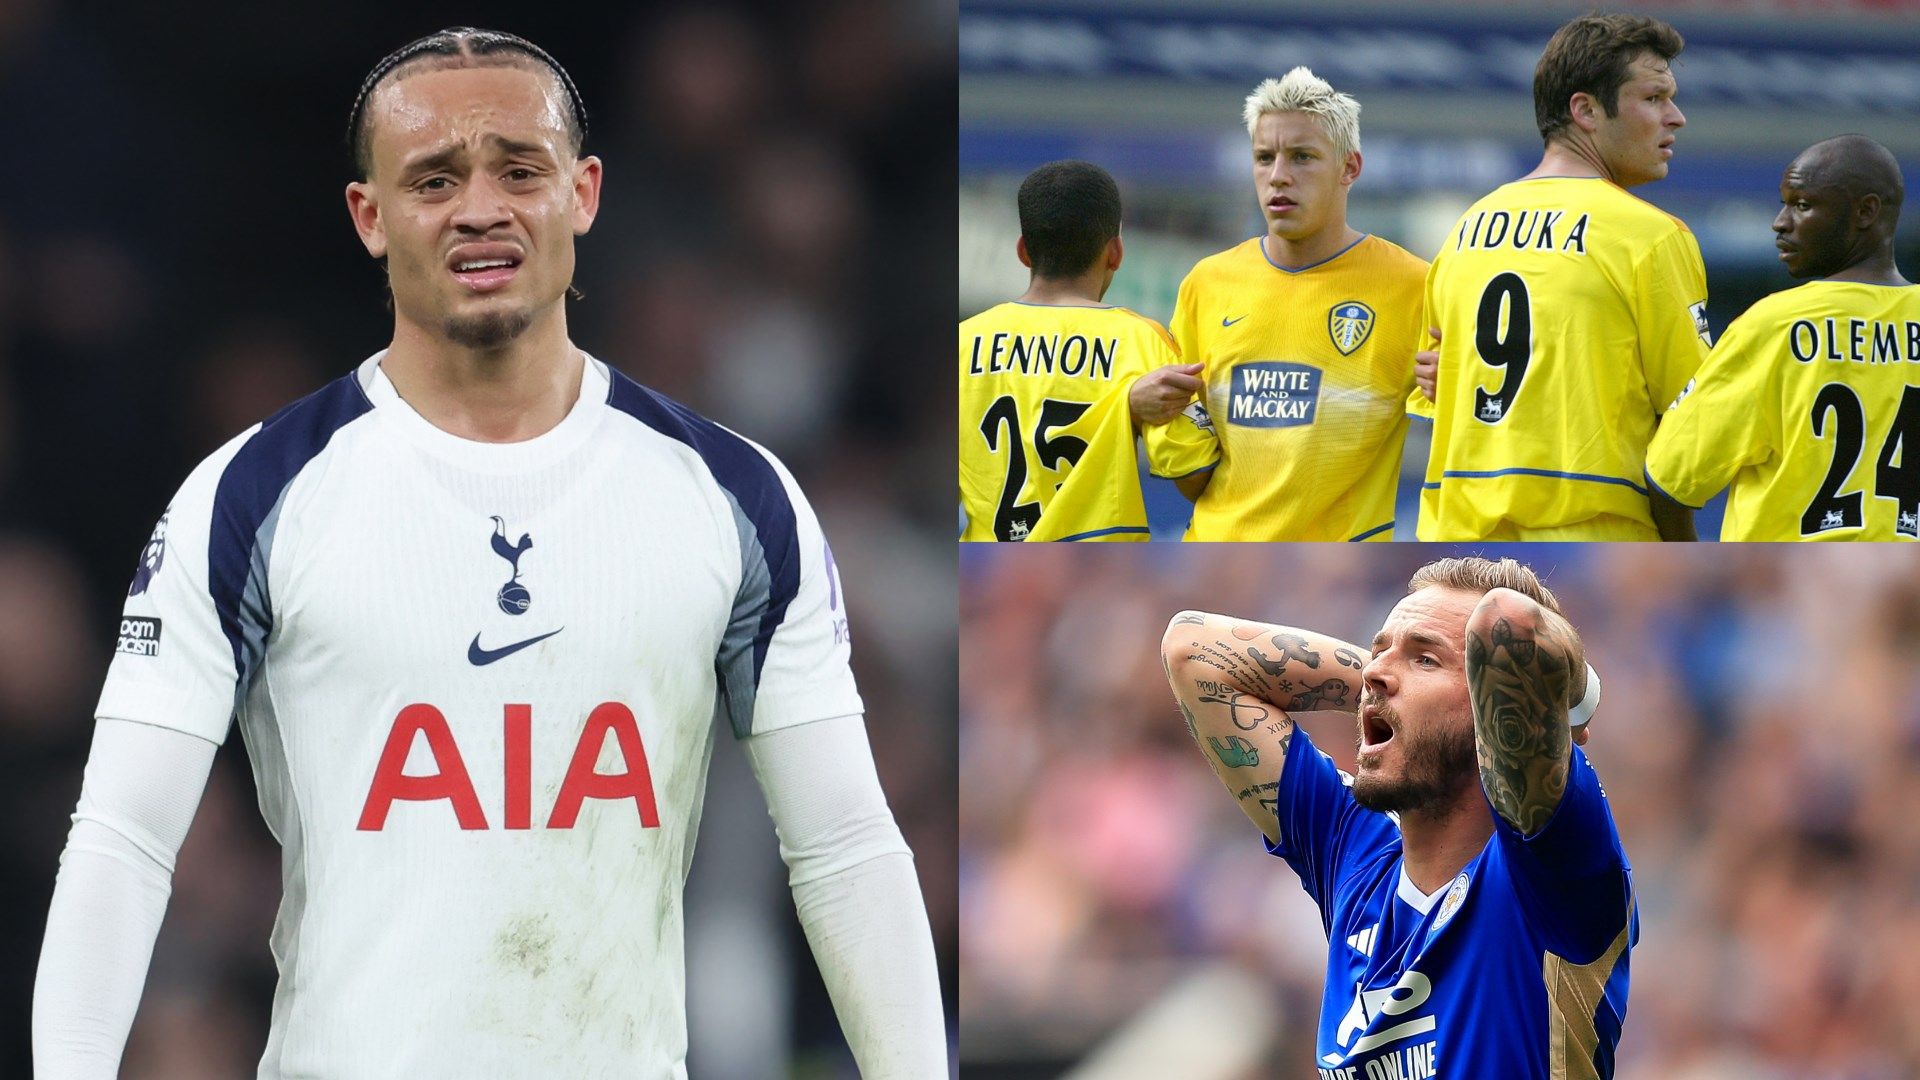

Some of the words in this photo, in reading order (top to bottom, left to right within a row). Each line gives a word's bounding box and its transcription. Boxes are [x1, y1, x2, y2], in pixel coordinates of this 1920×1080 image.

[969, 333, 1119, 380] LENNON
[1473, 272, 1533, 425] 9
[1242, 368, 1311, 393] WHYTE
[1259, 390, 1289, 399] AND
[1232, 394, 1312, 419] MACKAY
[1800, 382, 1920, 537] 24
[119, 619, 155, 638] oom
[115, 638, 159, 656] acism
[356, 701, 660, 831] AIA
[1365, 1040, 1437, 1080] ONLINE
